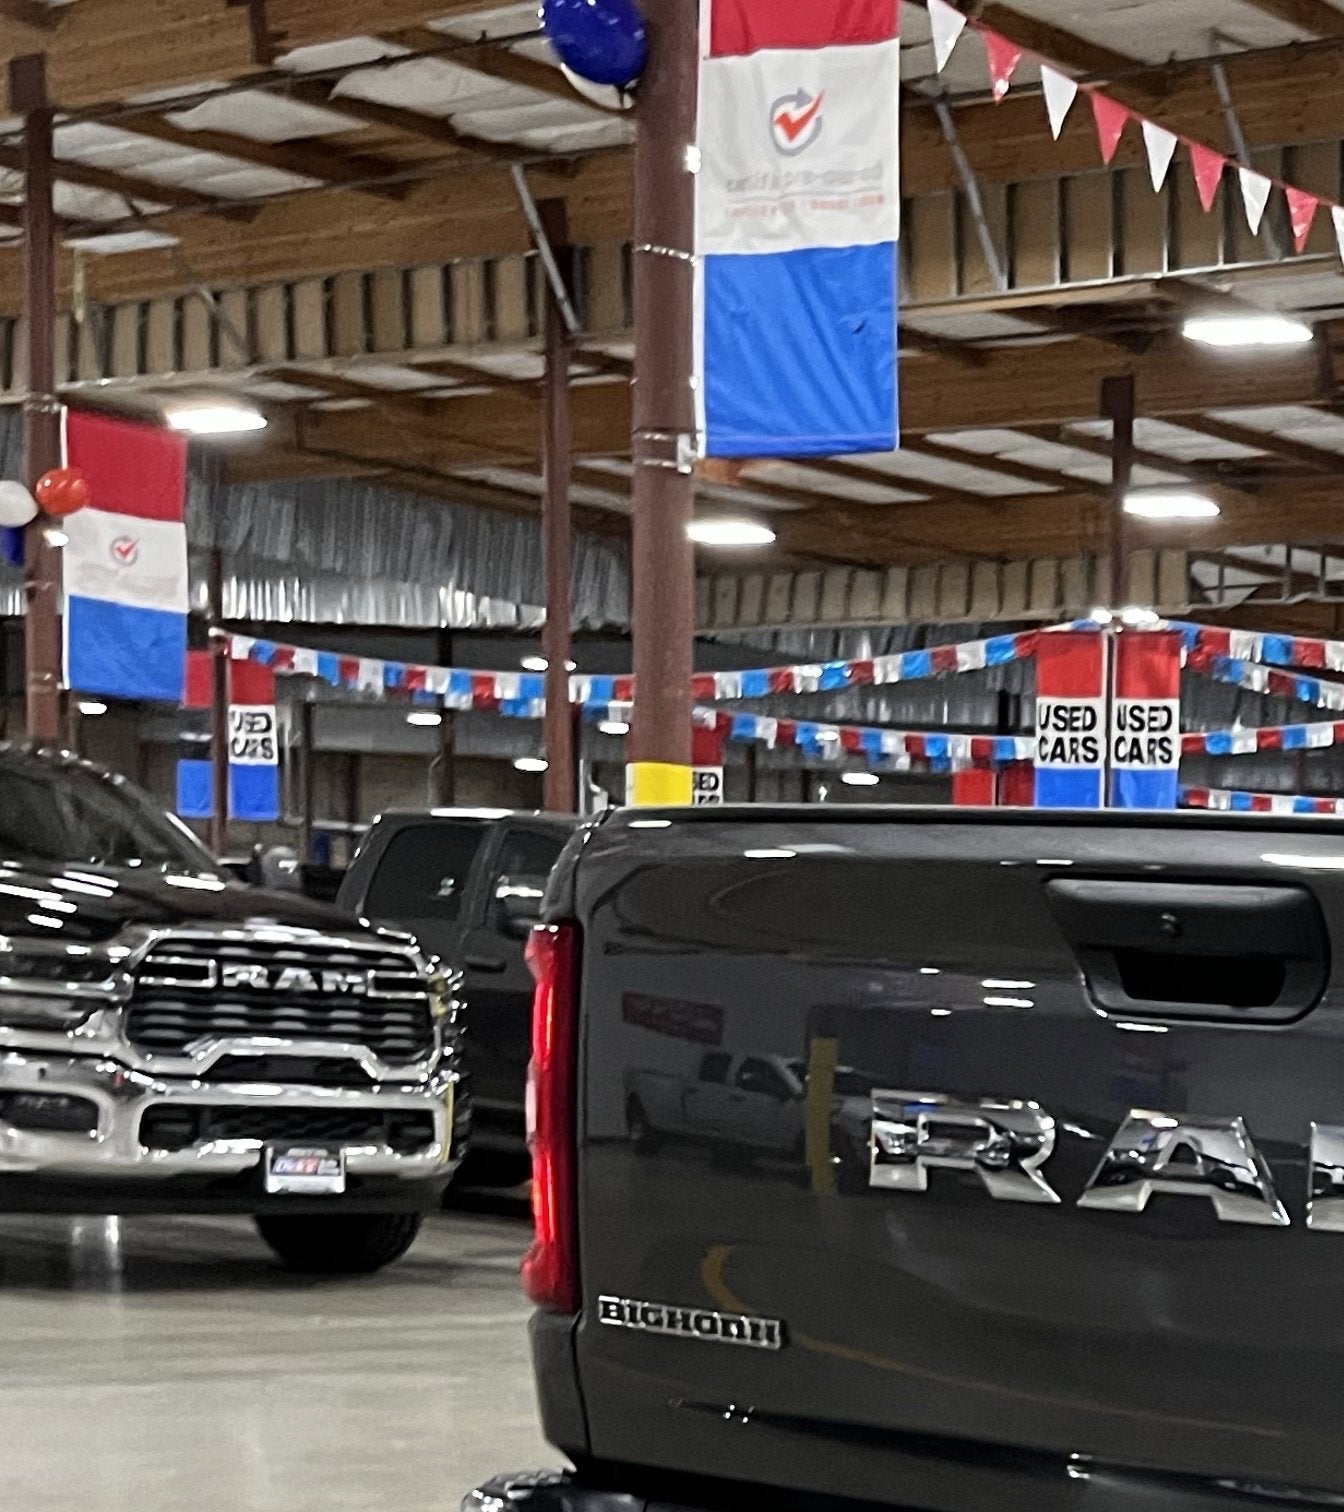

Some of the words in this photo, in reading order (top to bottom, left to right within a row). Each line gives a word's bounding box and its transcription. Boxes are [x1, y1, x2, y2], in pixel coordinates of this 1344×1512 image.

[231, 710, 272, 733] UED
[1039, 704, 1097, 732] USED
[1117, 704, 1172, 733] USED
[1038, 735, 1099, 763] CARS
[1114, 735, 1173, 764] CARS
[222, 964, 367, 994] RAM
